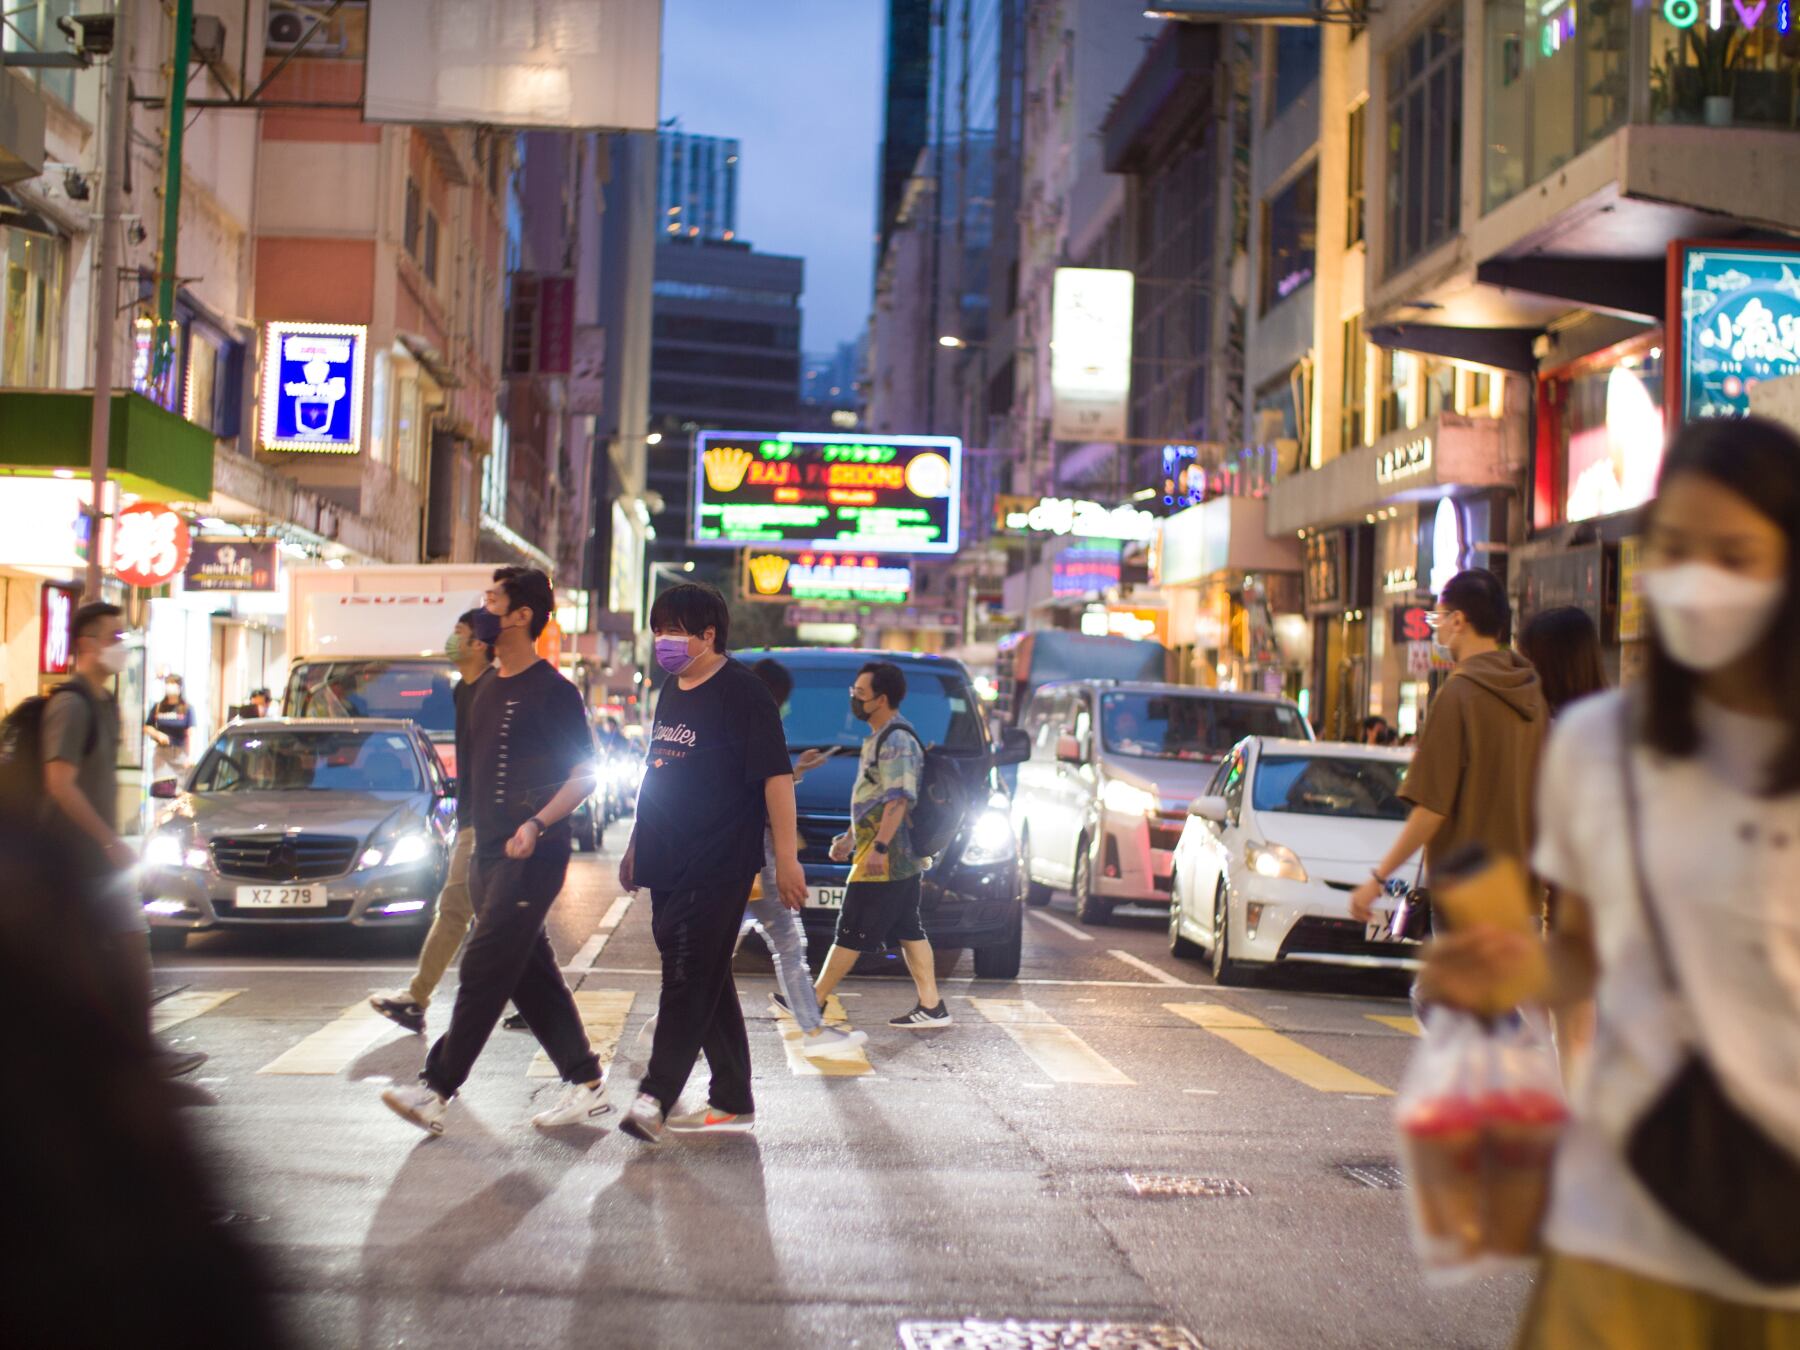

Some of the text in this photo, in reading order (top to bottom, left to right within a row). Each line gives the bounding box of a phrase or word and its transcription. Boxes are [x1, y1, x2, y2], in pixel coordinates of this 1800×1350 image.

[340, 596, 445, 606] ISUZU
[252, 889, 312, 904] XZ 279
